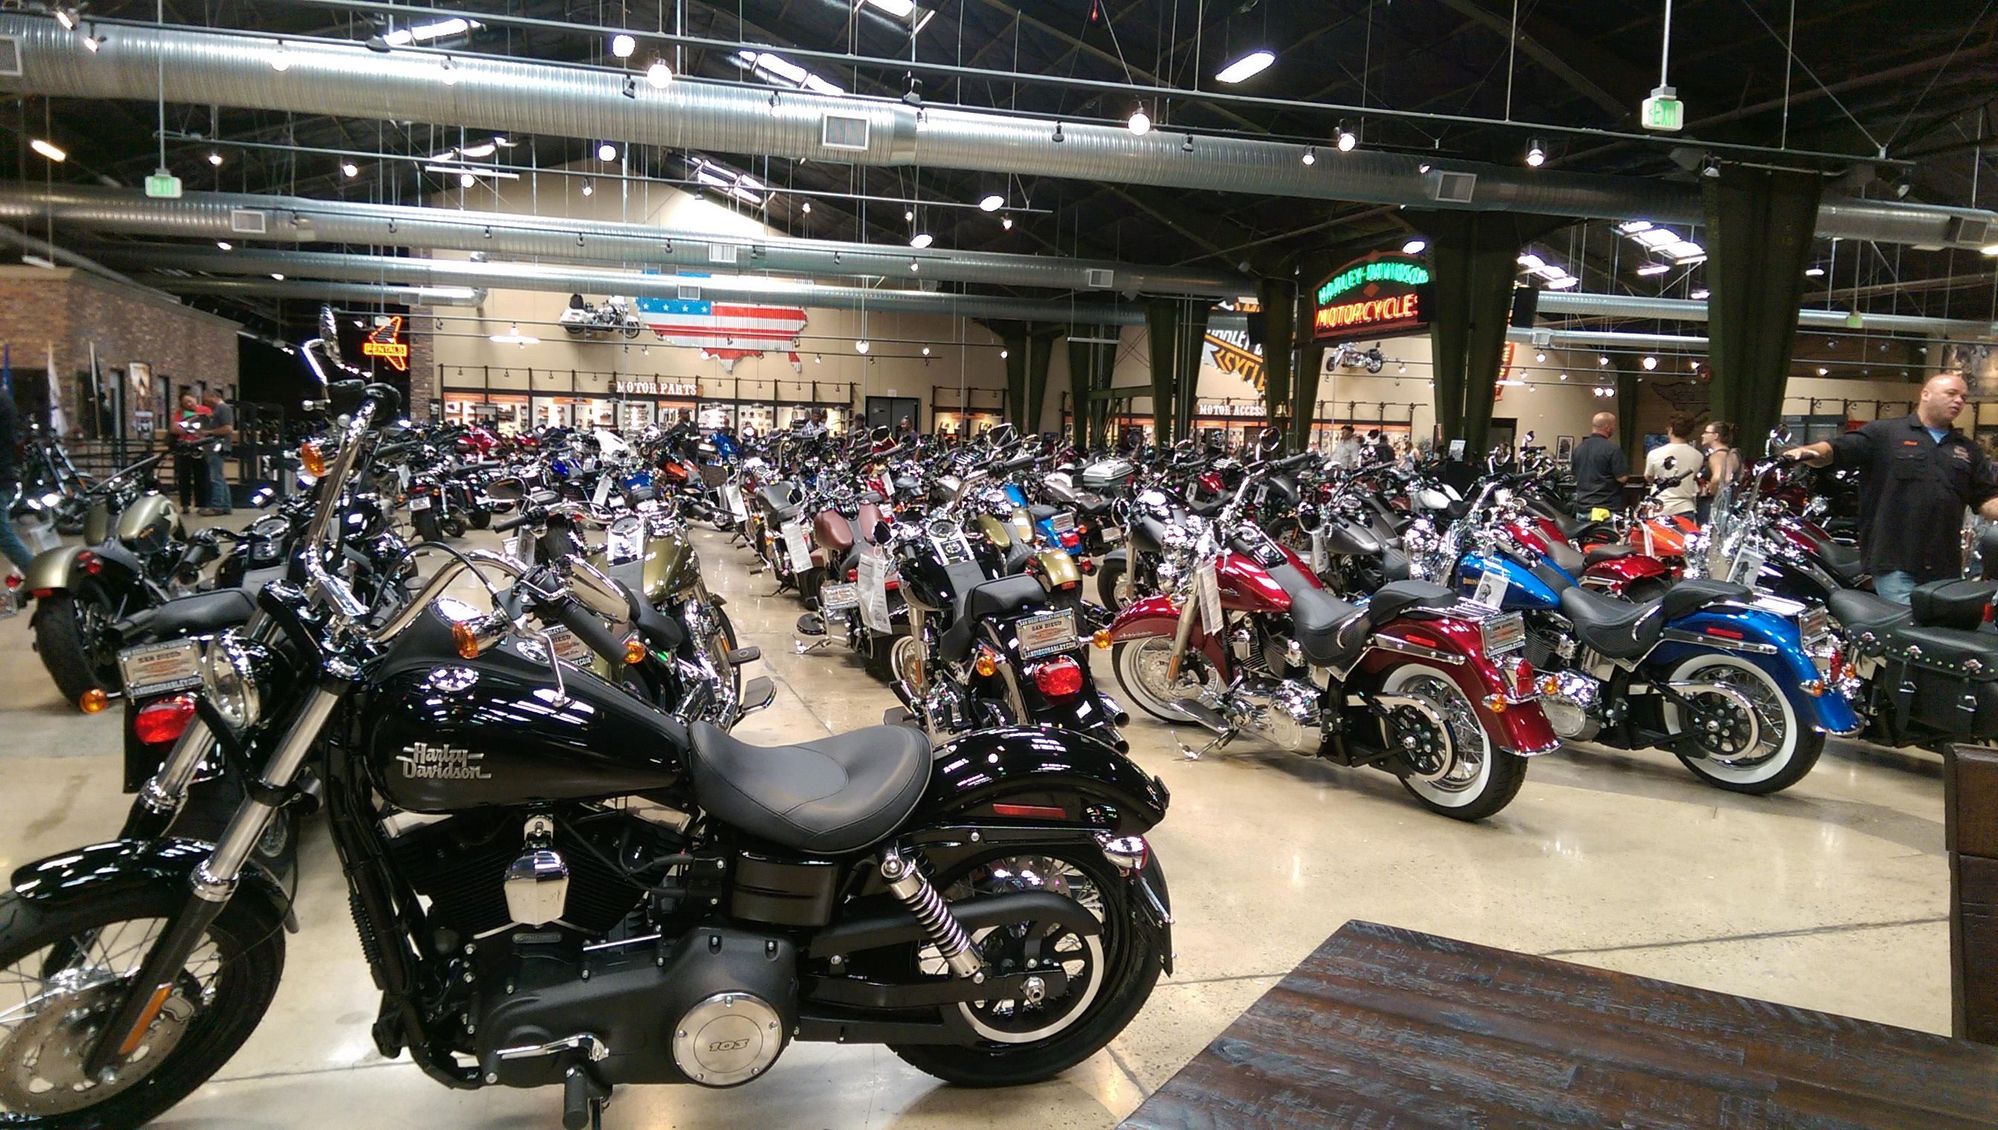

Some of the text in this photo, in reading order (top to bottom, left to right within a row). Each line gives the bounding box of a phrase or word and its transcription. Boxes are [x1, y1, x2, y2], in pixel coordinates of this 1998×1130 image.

[1318, 262, 1429, 305] HARLEY-DAVIDSON
[616, 381, 697, 396] MOTOR PARTS
[1200, 404, 1266, 417] MOTOR ACCESS
[403, 741, 484, 768] Harley
[395, 755, 491, 779] Davidson
